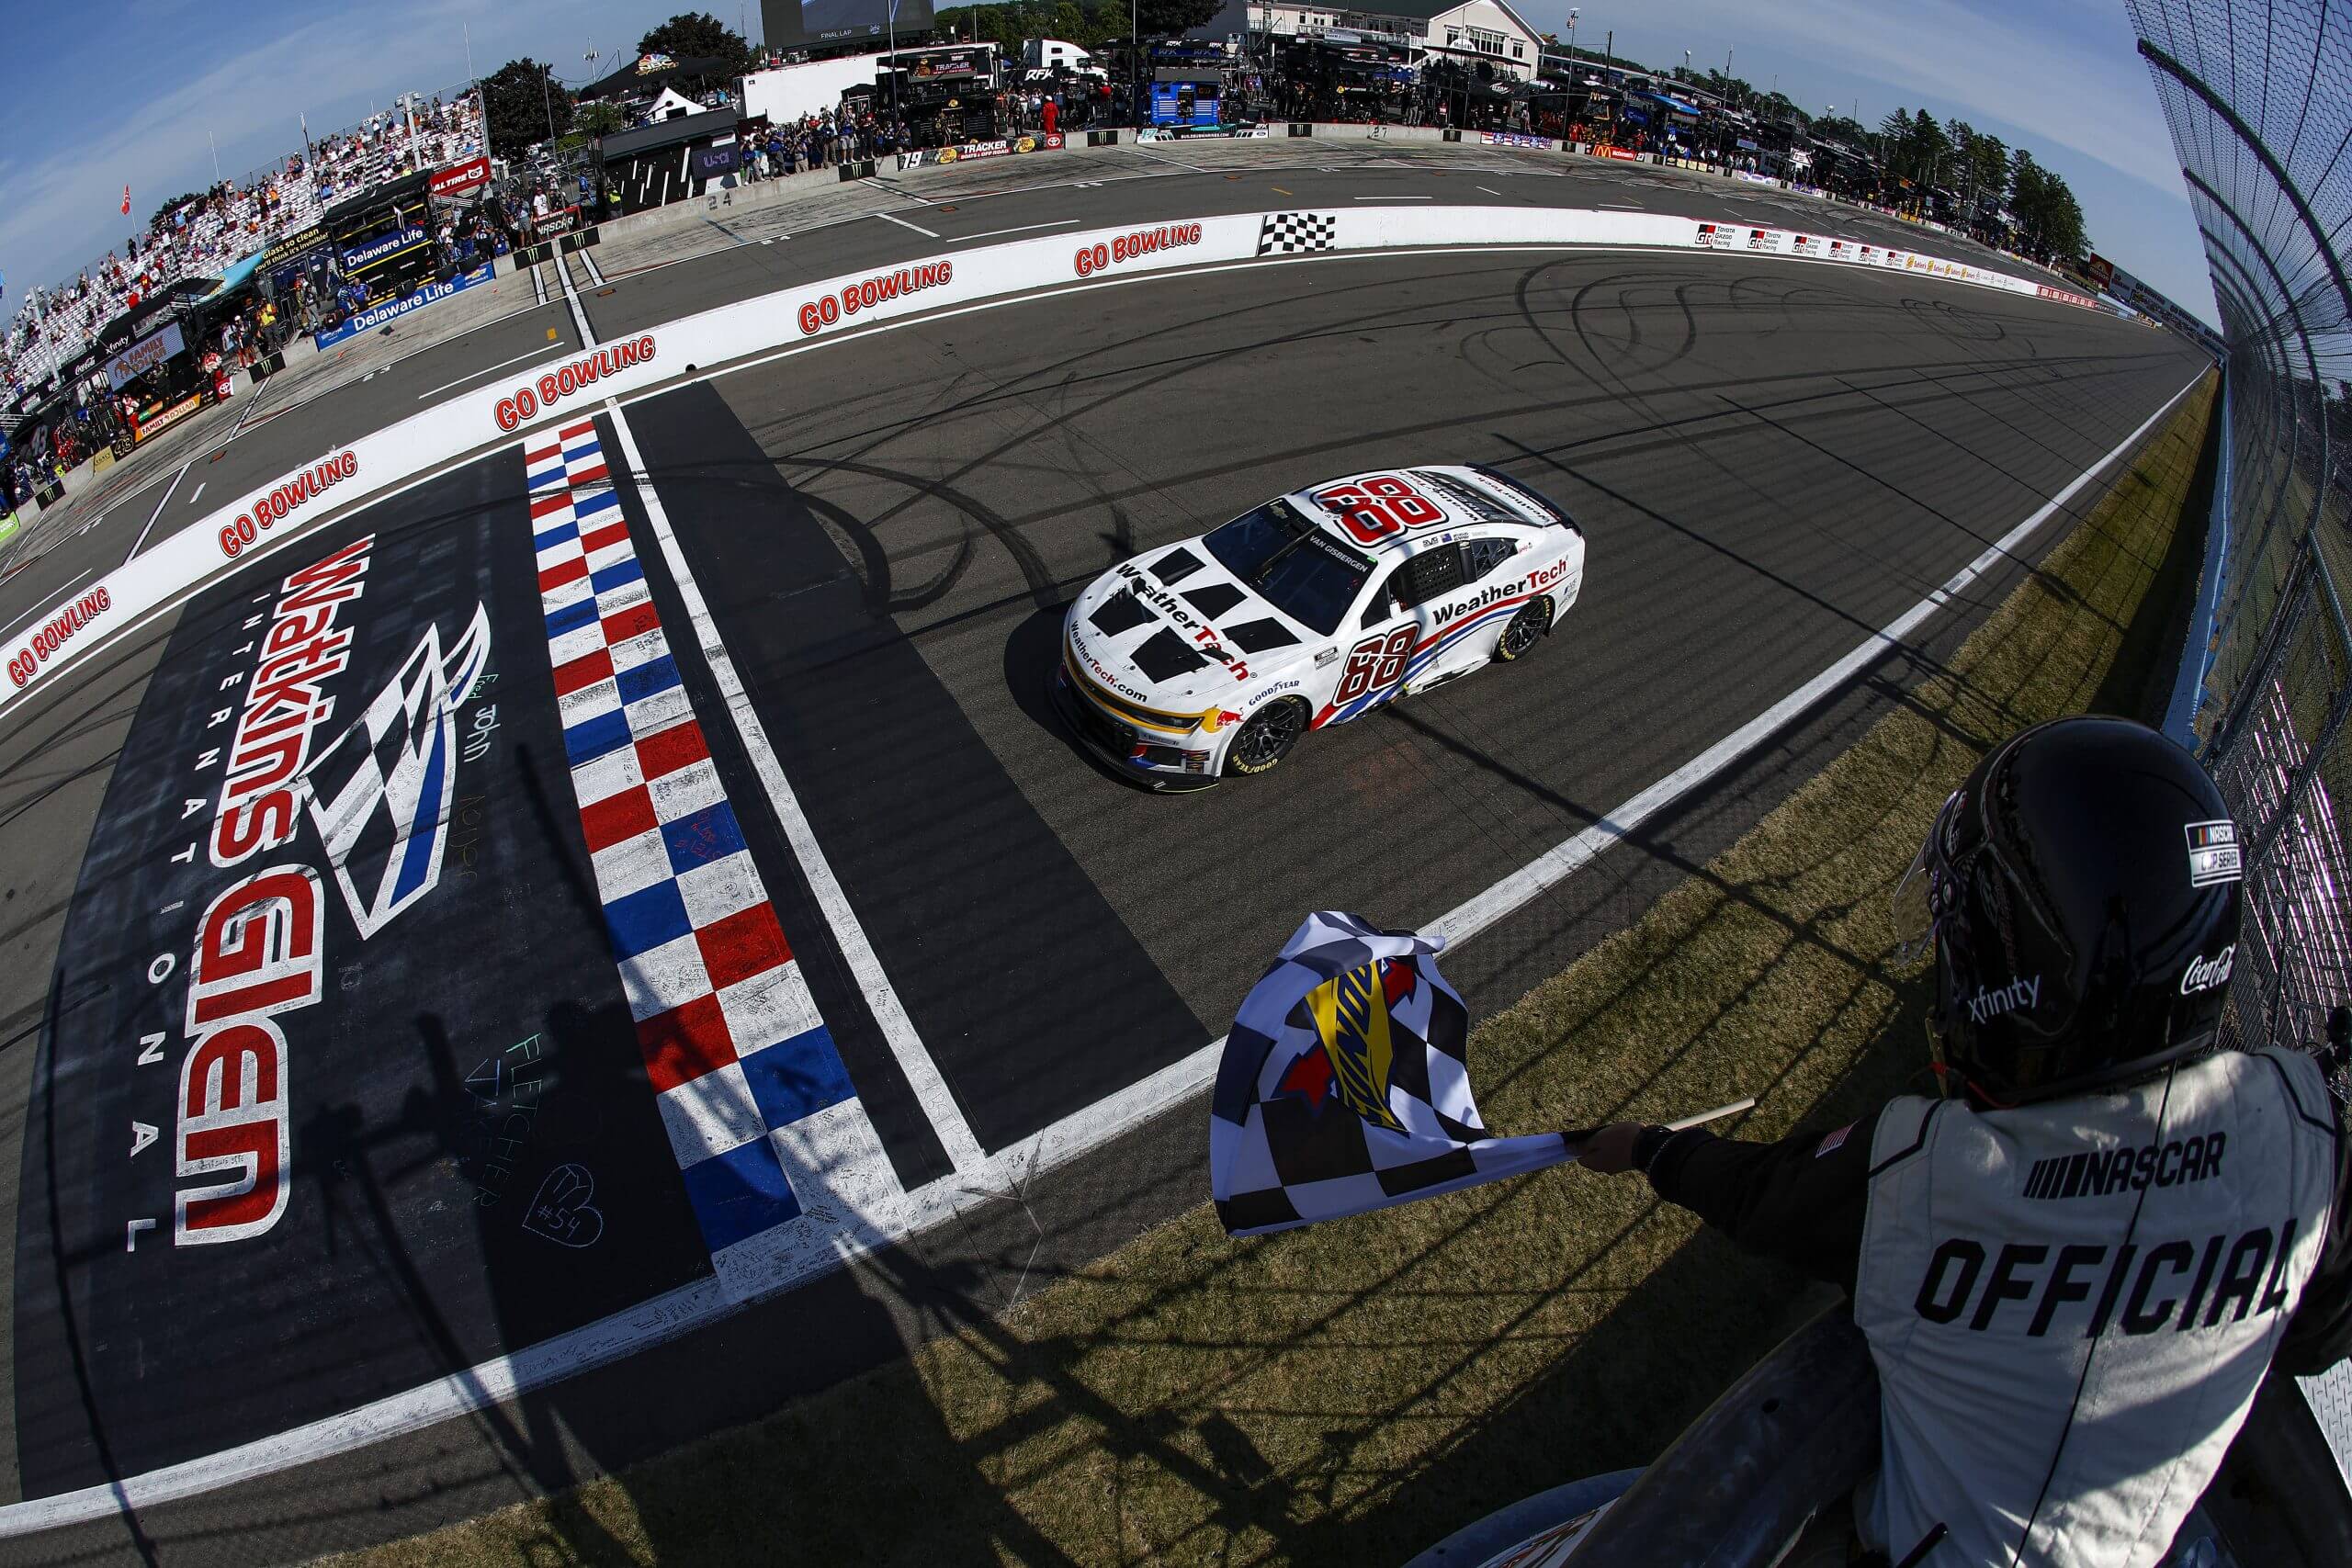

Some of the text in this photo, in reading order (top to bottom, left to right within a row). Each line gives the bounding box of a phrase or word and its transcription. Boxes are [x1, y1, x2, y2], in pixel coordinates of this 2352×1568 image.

[820, 29, 853, 39] FINAL LAP
[903, 152, 922, 169] 19
[964, 140, 1007, 154] TRACKER
[262, 228, 319, 260] Glass so clean
[537, 216, 574, 235] NASCAR
[1696, 232, 1713, 244] GR
[1713, 240, 1731, 248] Racing
[1717, 226, 1736, 234] TOYOTA
[1747, 238, 1762, 249] GR
[254, 231, 329, 274] you'll think it's invisible!
[347, 229, 424, 267] Delaware Life
[1073, 223, 1202, 277] GO BOWLING
[1792, 243, 1805, 253] GR
[354, 282, 455, 332] Delaware Life
[797, 261, 953, 335] GO BOWLING
[105, 335, 130, 355] xfinity
[494, 335, 655, 432] GO BOWLING
[114, 434, 133, 456] 43
[141, 419, 164, 435] FAMILY
[219, 451, 357, 558] GO BOWLING
[1309, 475, 1449, 548] 88
[1309, 535, 1369, 572] VAN GISBERGEN
[1433, 559, 1567, 626] WeatherTech
[6, 586, 111, 688] GO BOWLING
[1115, 563, 1250, 682] WatherTech
[1069, 620, 1148, 703] WeatherTech.com
[1332, 621, 1421, 707] 88
[1249, 680, 1300, 706] GOODYEAR
[463, 705, 502, 763] John
[1232, 754, 1279, 774] GOODYEAR
[175, 533, 376, 1247] Watkins Glen
[126, 592, 272, 1253] INTERNATIONAL
[1967, 975, 2041, 1025] xfinity
[2081, 1131, 2228, 1194] NASCAR
[537, 1205, 581, 1240] #54
[1914, 1218, 2297, 1339] OFFICIAL
